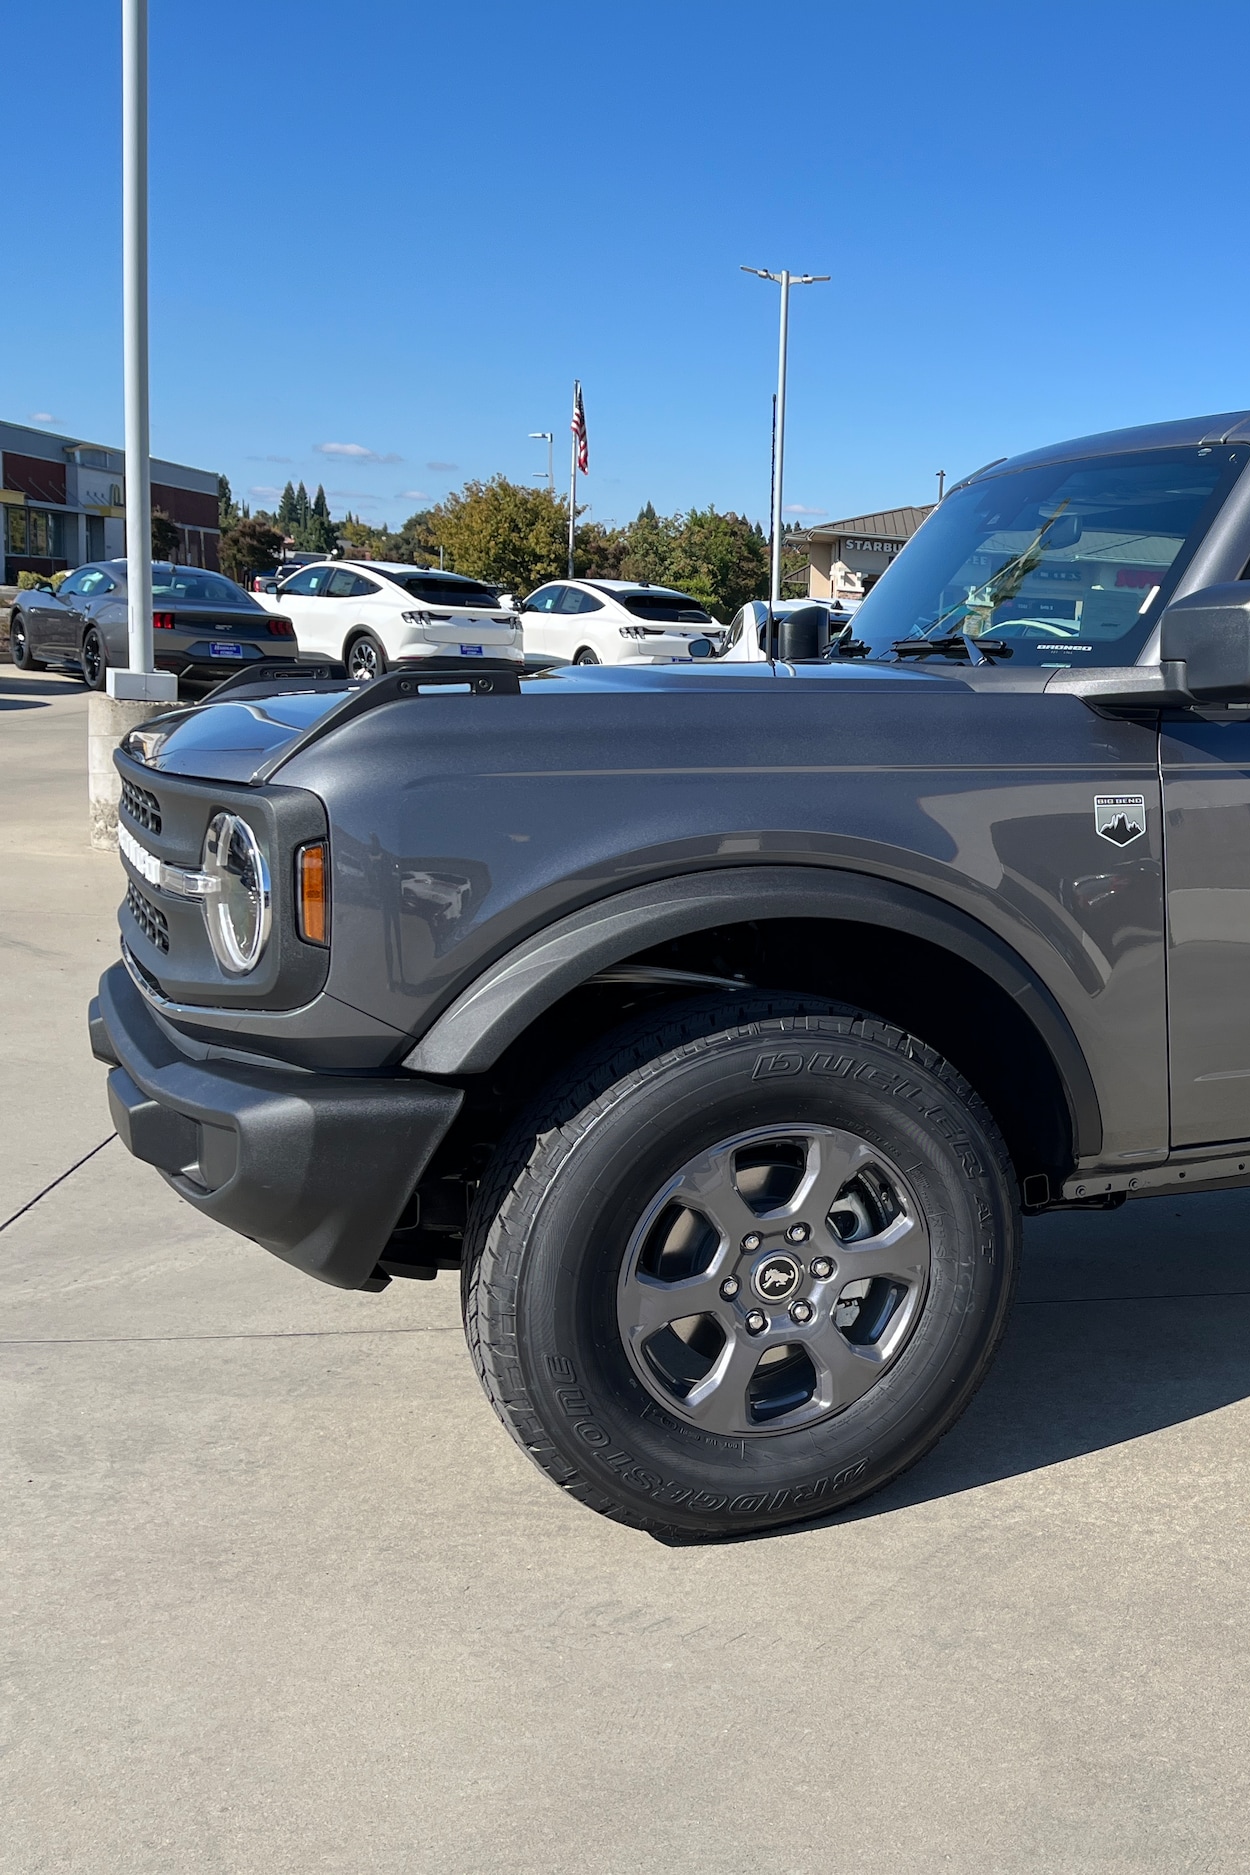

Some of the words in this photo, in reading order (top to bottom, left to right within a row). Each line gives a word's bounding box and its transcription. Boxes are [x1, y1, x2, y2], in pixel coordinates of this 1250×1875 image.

[846, 539, 904, 553] STARBU
[752, 1051, 986, 1180] DUELER
[543, 1351, 872, 1515] BRIDGESTONE
